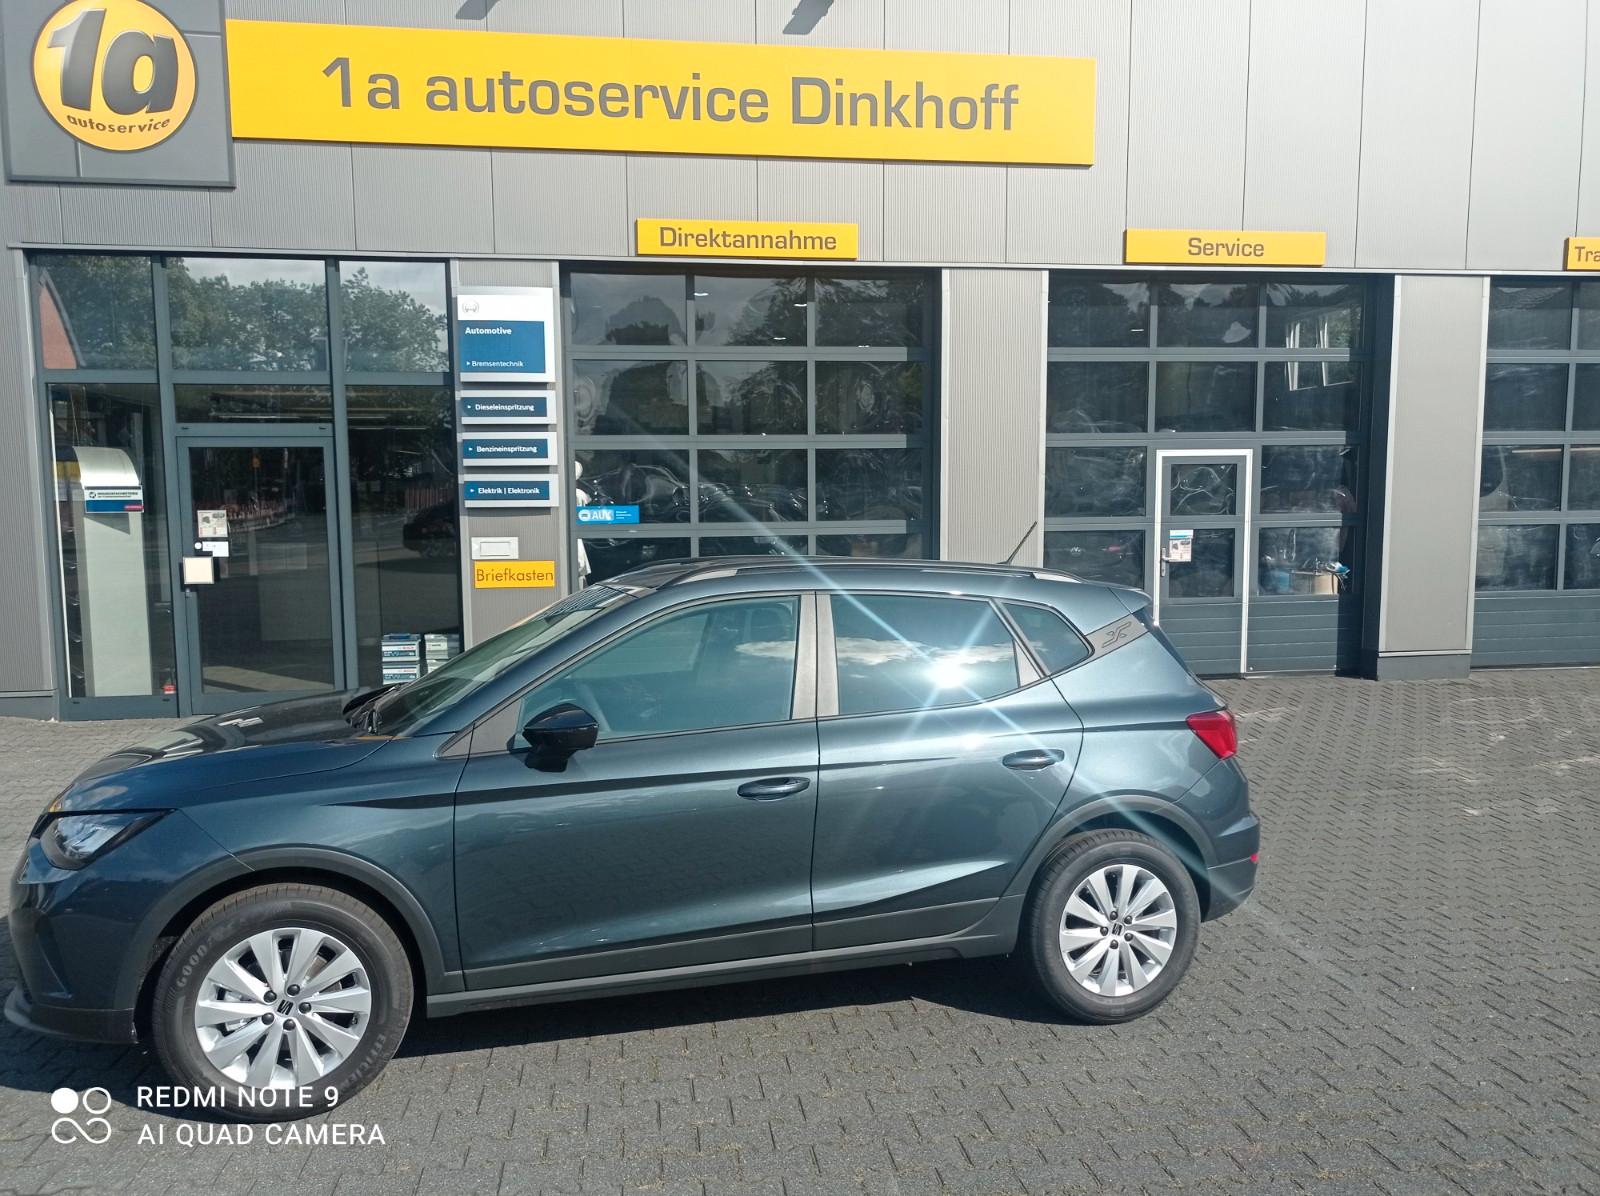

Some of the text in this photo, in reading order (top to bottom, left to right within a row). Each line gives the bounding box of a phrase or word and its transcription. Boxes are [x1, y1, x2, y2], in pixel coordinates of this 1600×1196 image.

[48, 8, 179, 116] 1a
[322, 57, 1020, 131] 1a autoservice Dinkhoff
[66, 114, 171, 134] autoservice
[659, 226, 837, 251] Direktannahme
[1187, 236, 1265, 257] Service
[464, 326, 513, 335] Automotive
[471, 360, 524, 368] Bremsentechnik
[474, 403, 535, 412] Dieseleinspritzung
[476, 445, 538, 454] Benzineinspritzung
[477, 487, 503, 495] Elektrik
[507, 487, 540, 495] Elektronik
[476, 567, 554, 582] Briefkasten
